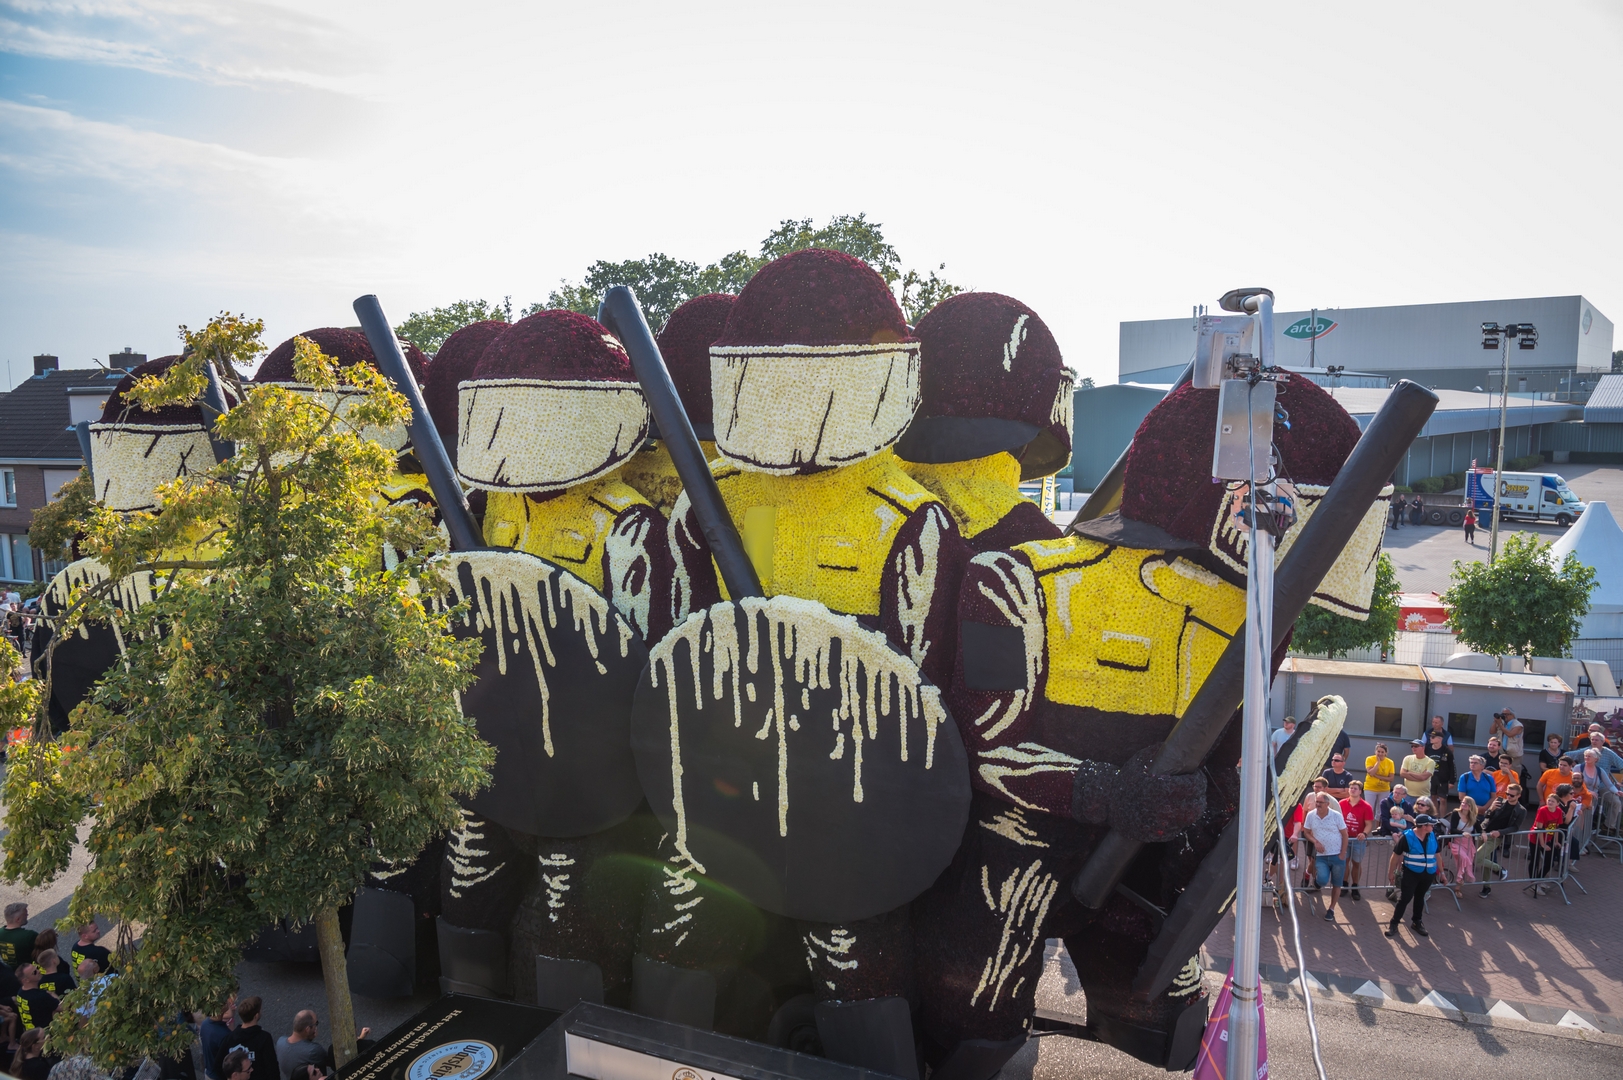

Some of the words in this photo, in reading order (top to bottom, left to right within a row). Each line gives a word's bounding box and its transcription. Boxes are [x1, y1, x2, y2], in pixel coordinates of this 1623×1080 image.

[1505, 484, 1530, 492] SNEP
[413, 1022, 428, 1031] en
[440, 1009, 463, 1022] Het
[384, 1030, 415, 1053] samen
[405, 1022, 445, 1049] verschil
[345, 1051, 386, 1080] genieten
[373, 1048, 409, 1072] tussen
